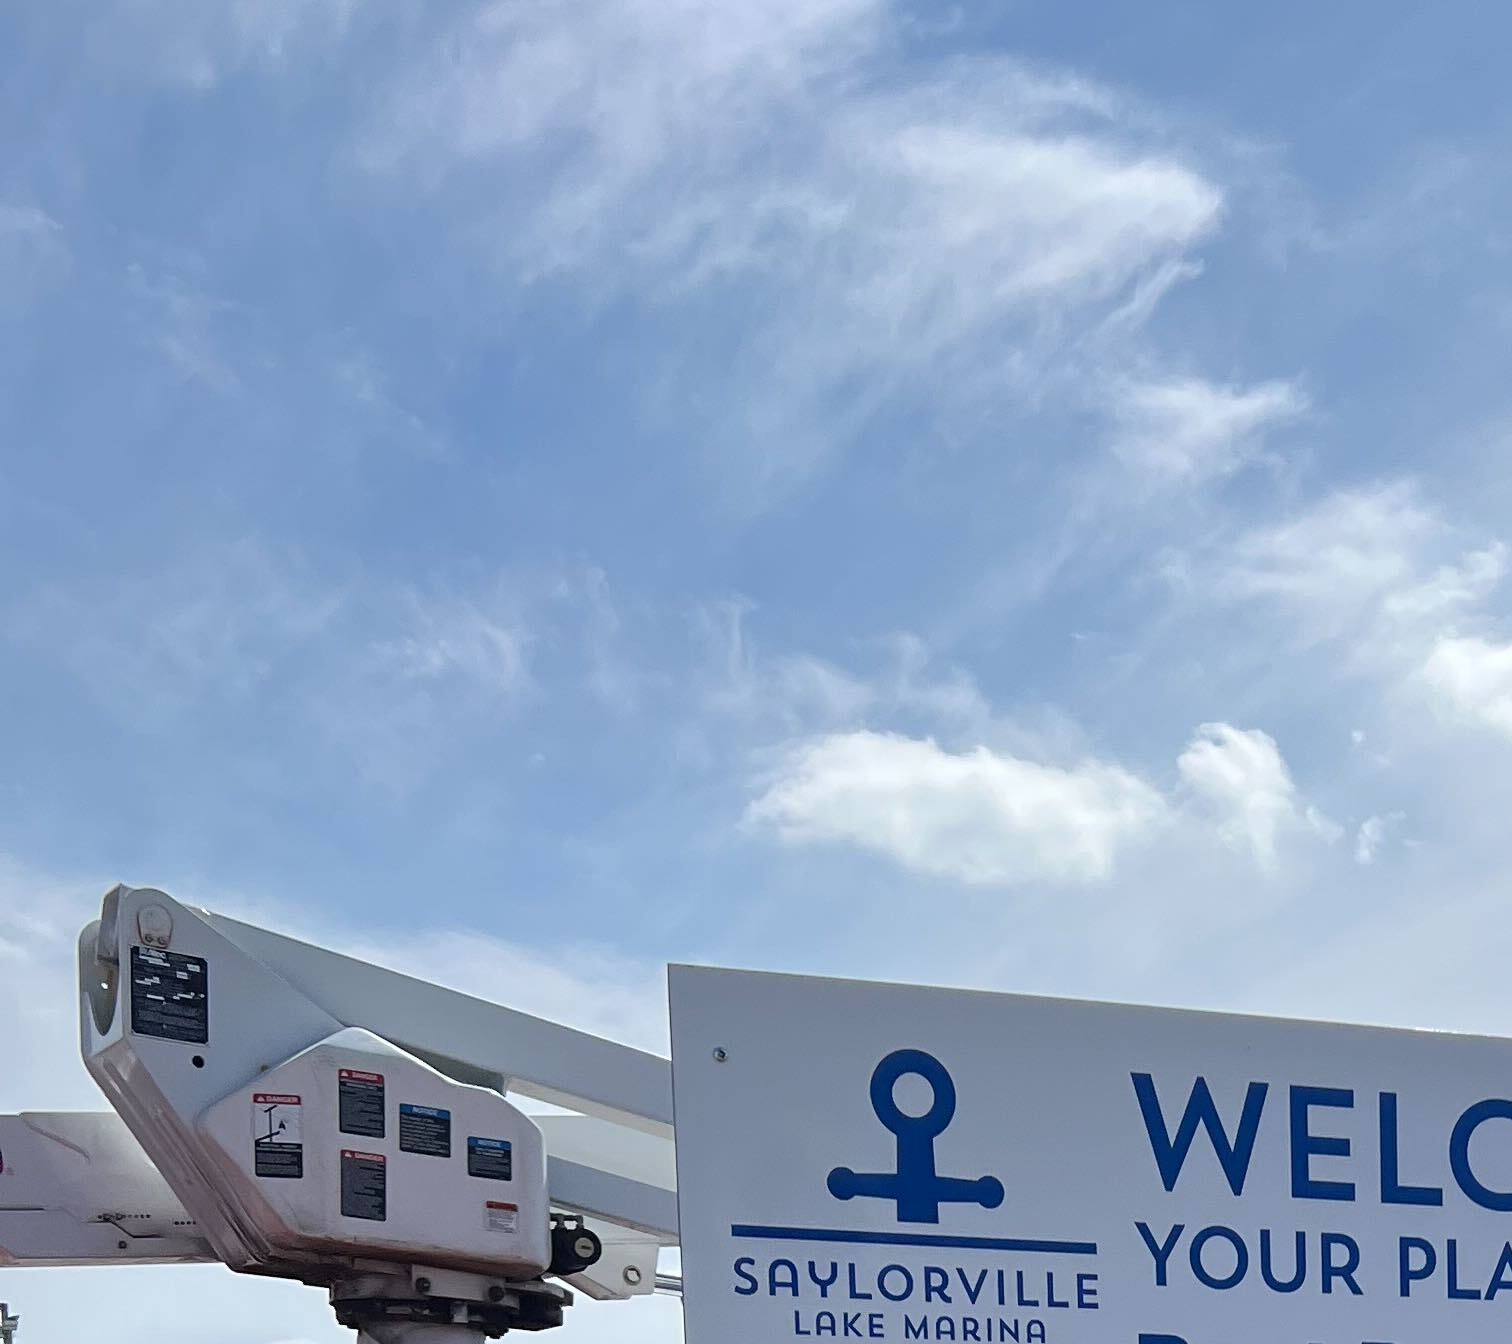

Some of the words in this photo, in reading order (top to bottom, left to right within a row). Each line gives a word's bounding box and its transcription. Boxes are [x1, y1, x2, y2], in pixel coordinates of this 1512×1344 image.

[734, 1256, 1101, 1311] SAYLORVILLE
[1136, 1222, 1365, 1297] YOUR
[793, 1310, 886, 1339] LAKE
[904, 1314, 1047, 1344] MARINA
